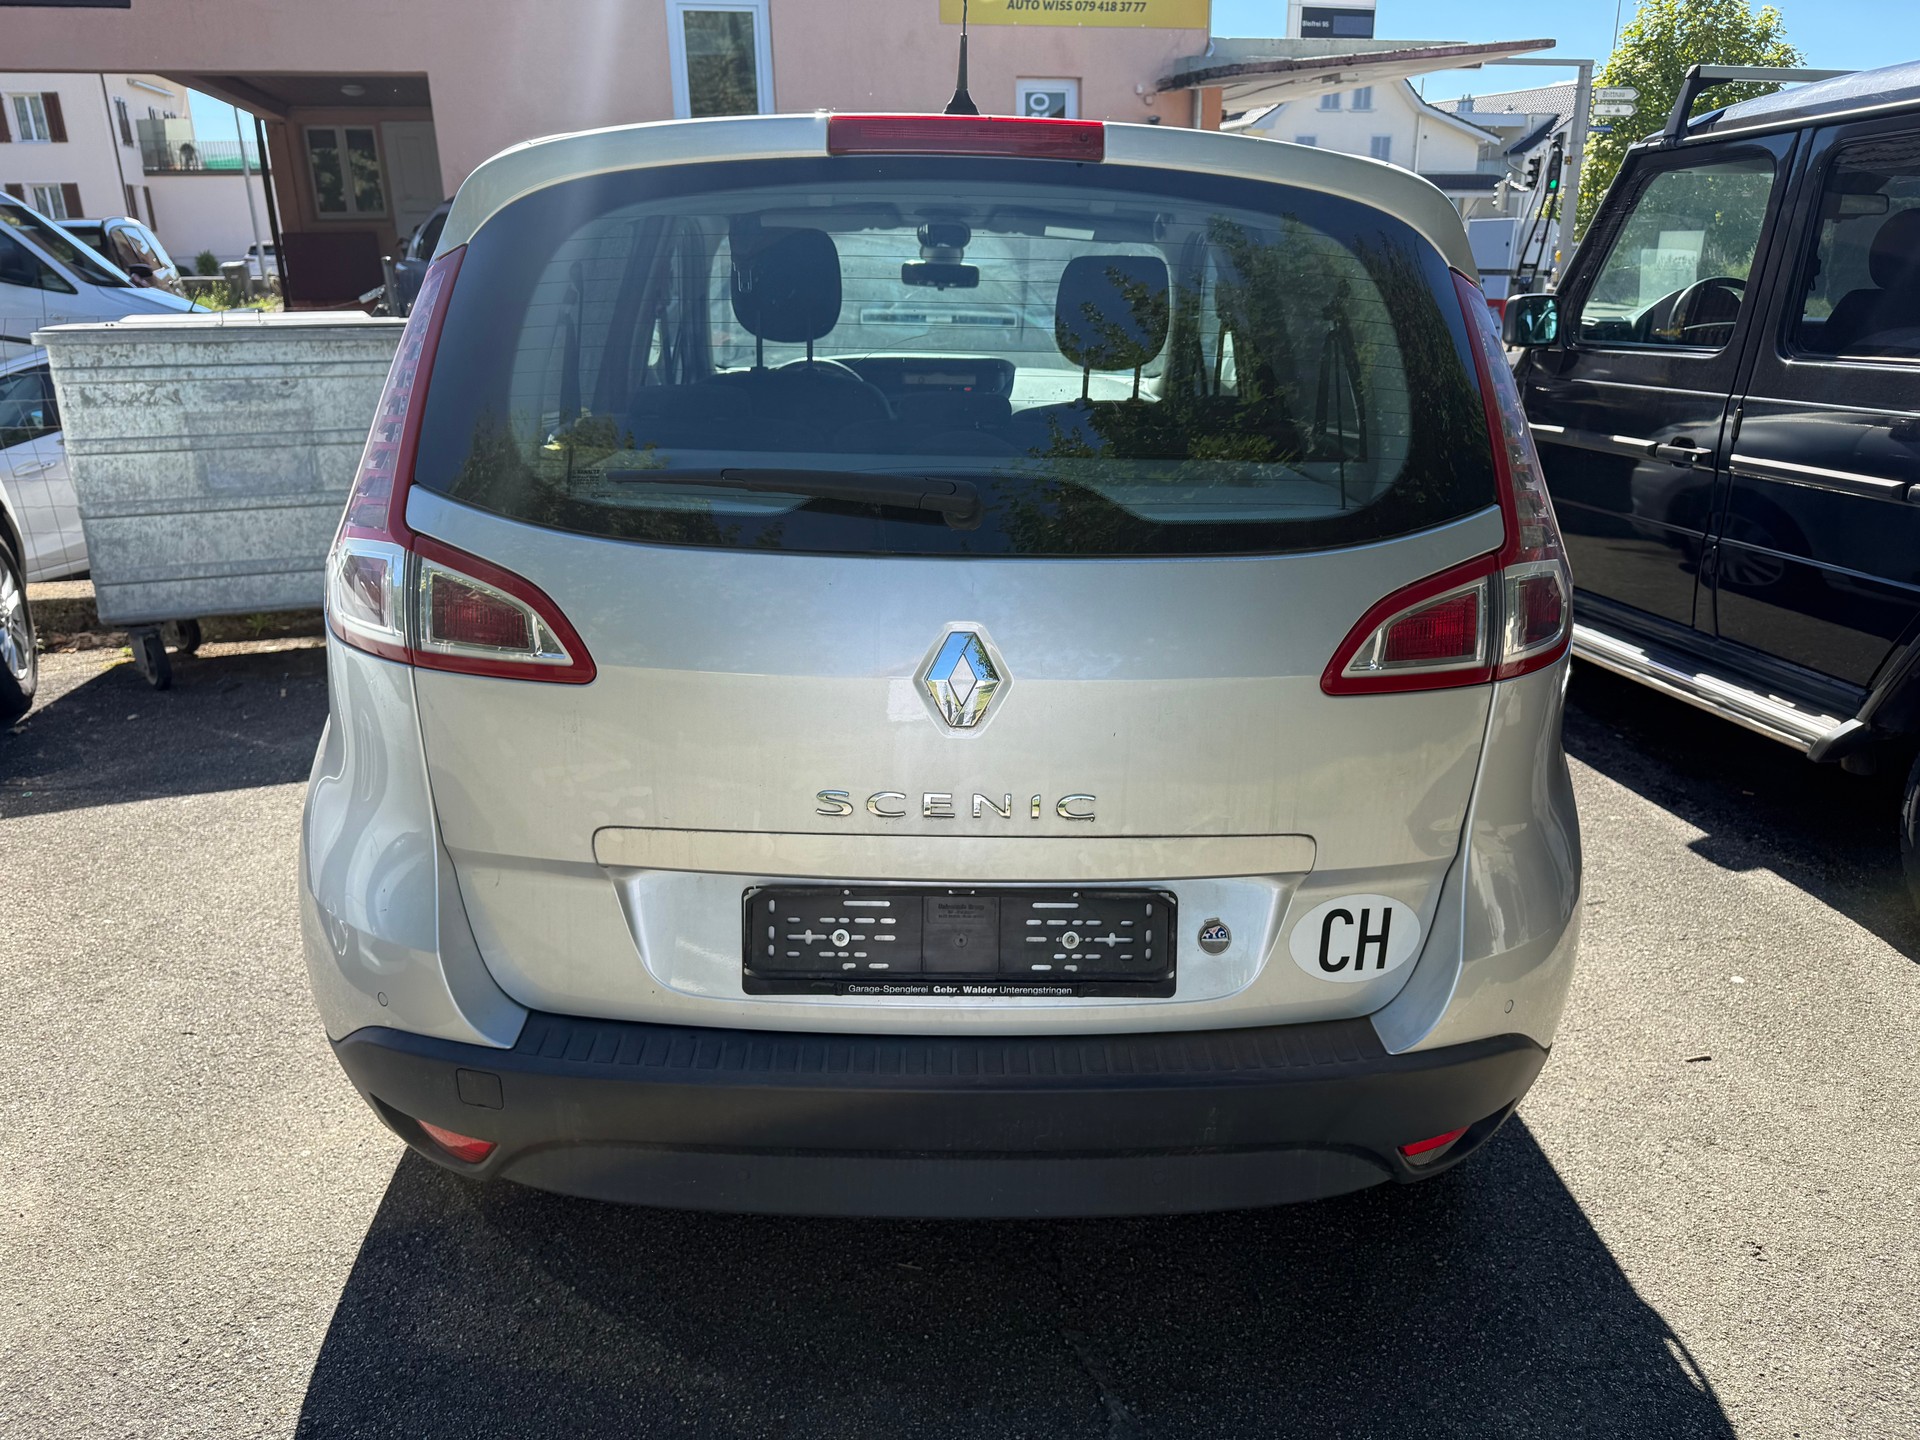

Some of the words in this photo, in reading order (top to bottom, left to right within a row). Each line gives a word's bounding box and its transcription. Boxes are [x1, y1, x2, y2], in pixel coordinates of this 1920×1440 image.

[1006, 0, 1040, 10] AUTO
[1043, 0, 1073, 11] WISS
[1074, 1, 1096, 12] 079
[1097, 2, 1118, 12] 418
[816, 789, 1097, 822] SCENIC
[1319, 907, 1392, 973] CH
[848, 984, 929, 995] Garage-Spenglerei
[933, 985, 960, 994] Gebr.
[963, 985, 998, 995] Walder
[999, 986, 1073, 996] Unterengstringen
